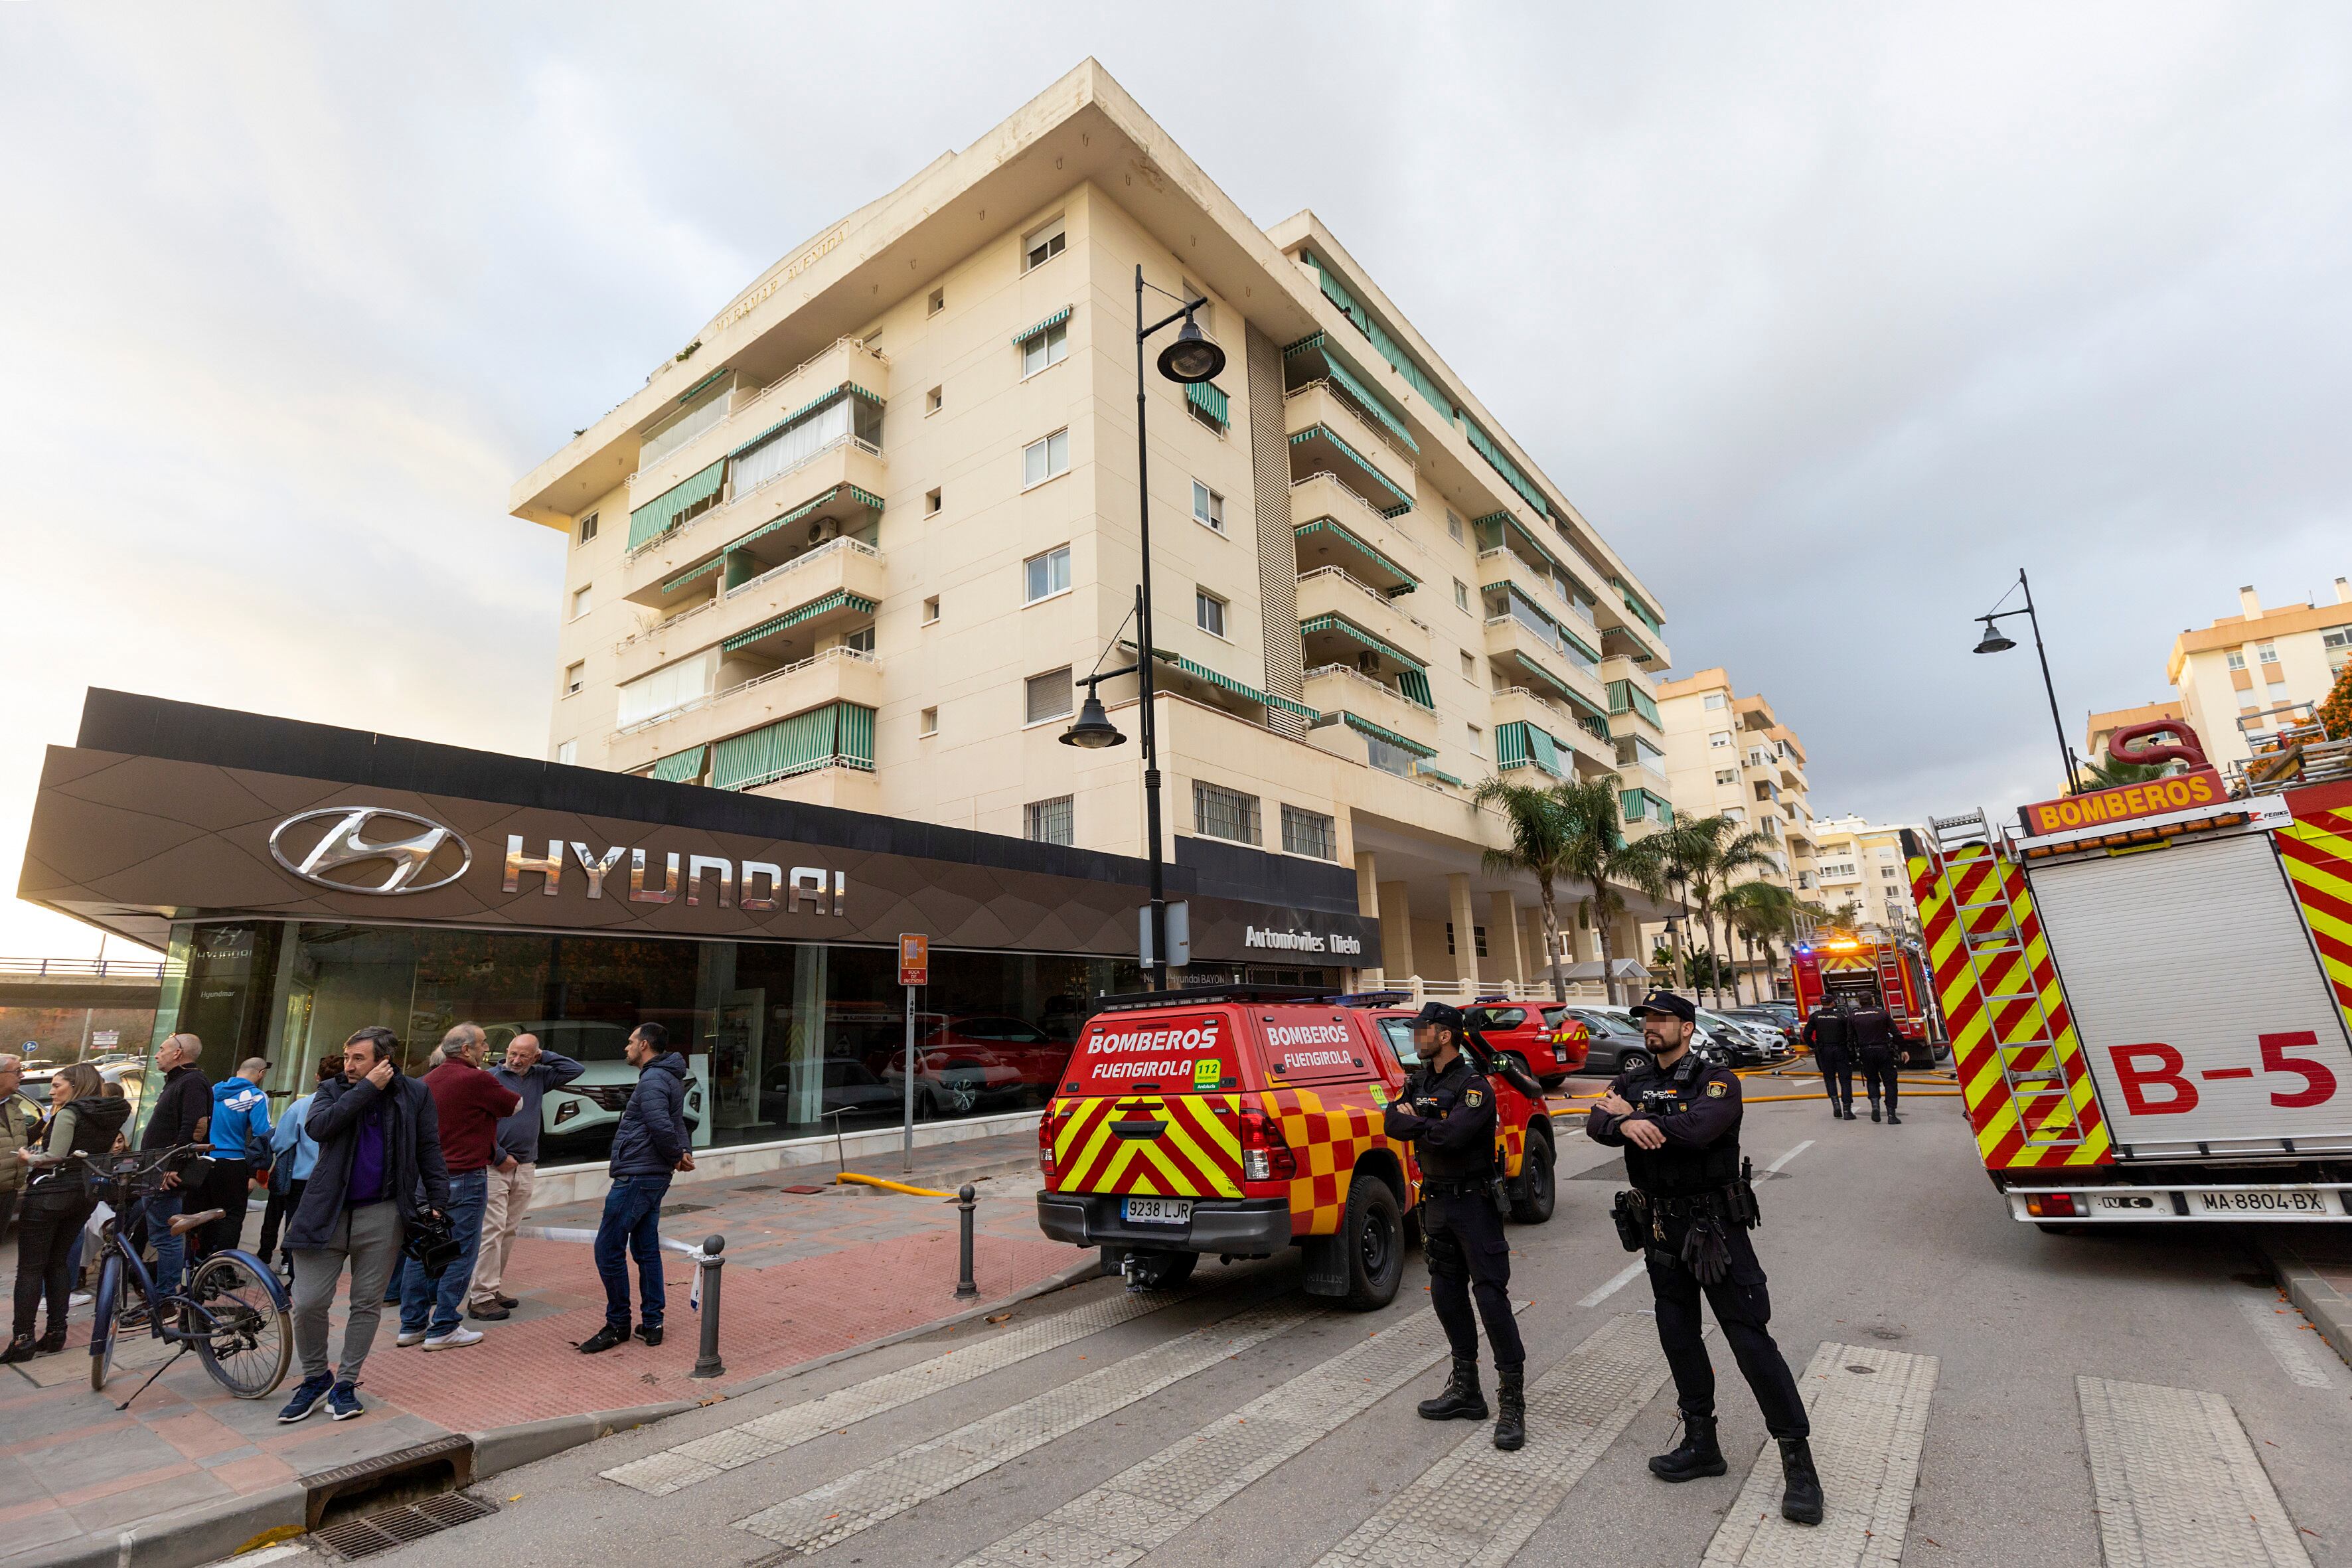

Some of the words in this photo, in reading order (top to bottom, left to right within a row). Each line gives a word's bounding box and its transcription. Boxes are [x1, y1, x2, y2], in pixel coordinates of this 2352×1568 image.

[716, 280, 778, 335] MYRAMAR
[787, 230, 844, 283] AVENIDA
[2038, 775, 2213, 830] BOMBEROS
[502, 834, 845, 917] HYUNDAI
[1245, 925, 1325, 953] Automóviles
[1330, 933, 1361, 955] Nieto
[1170, 973, 1200, 984] Hyundai
[1201, 974, 1225, 984] BAYON
[200, 990, 236, 999] Hyundmar
[1087, 1028, 1219, 1054] BOMBEROS
[1267, 1025, 1350, 1046] BOMBEROS
[1091, 1059, 1192, 1079] FUENGIROLA
[1198, 1063, 1218, 1074] 112
[1284, 1050, 1352, 1068] FUENGIROLA
[2108, 1030, 2337, 1116] B-5
[1372, 1088, 1383, 1097] 112
[1129, 1201, 1160, 1217] 9238
[1164, 1202, 1189, 1219] LJR
